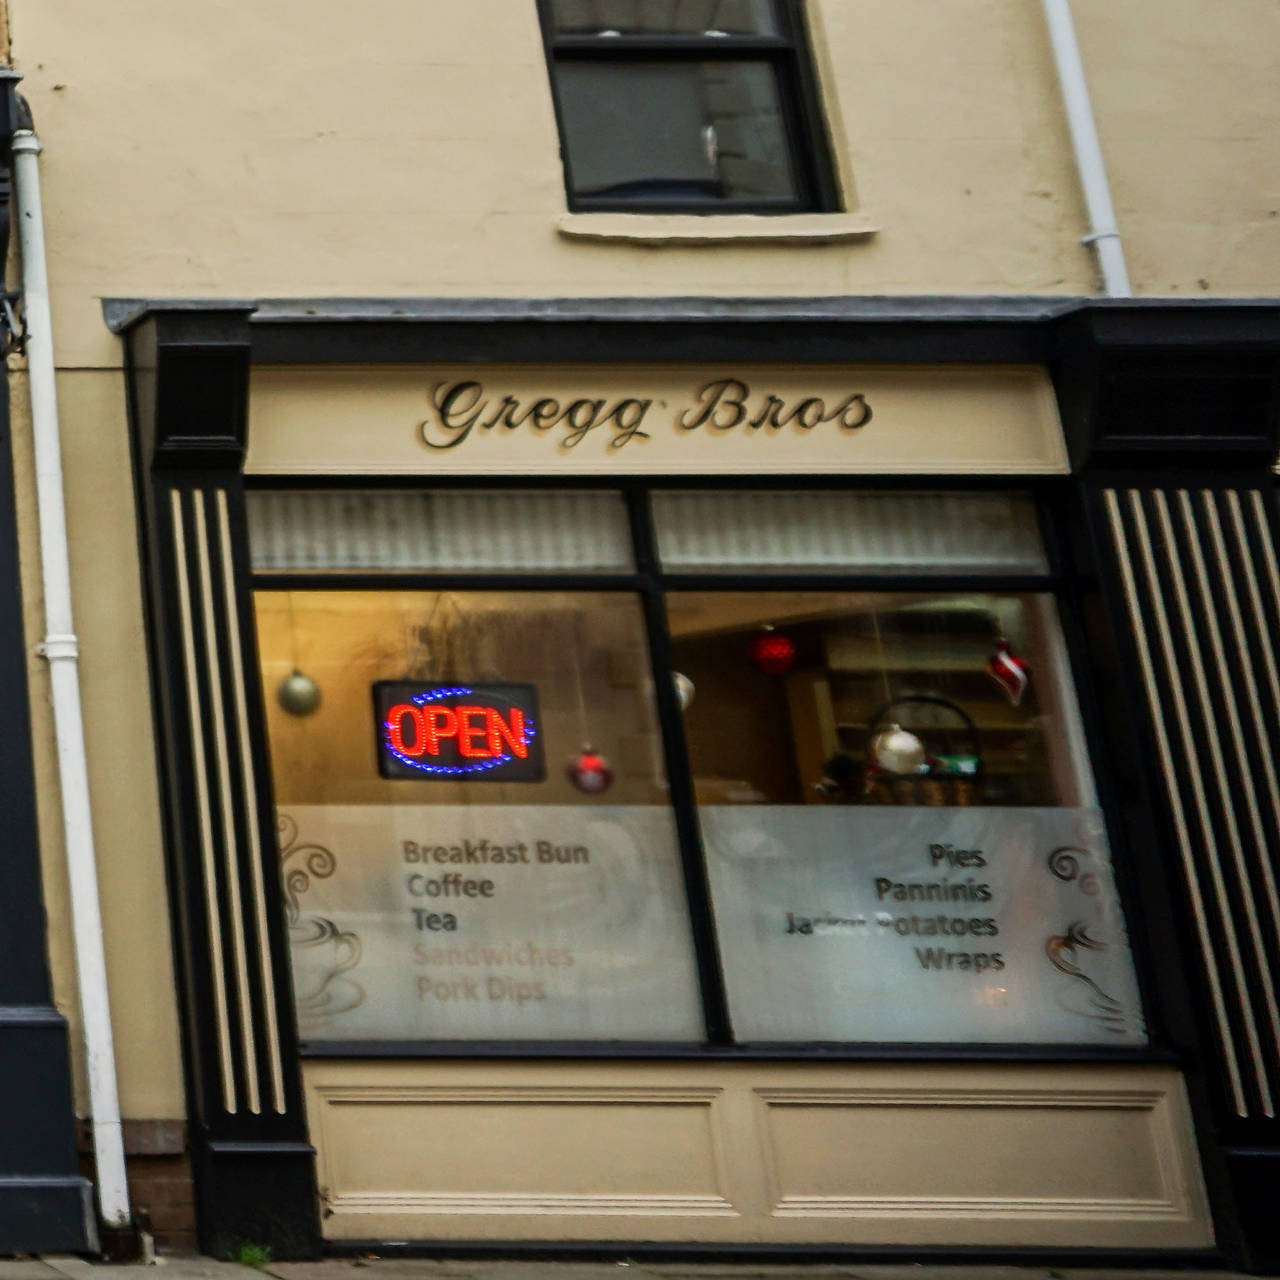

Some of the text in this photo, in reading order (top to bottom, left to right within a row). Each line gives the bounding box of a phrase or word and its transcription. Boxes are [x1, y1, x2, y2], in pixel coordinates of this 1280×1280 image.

[421, 378, 874, 449] Gregg Bros
[388, 704, 528, 759] OPEN
[403, 839, 589, 864] Breakfast Bun
[929, 843, 987, 868] Pies
[407, 873, 495, 898] Coffee
[875, 877, 993, 903] Panninis
[411, 907, 458, 931] Tea
[412, 942, 574, 967] Sandwiches
[914, 946, 1006, 973] Wraps
[416, 975, 547, 1006] Pork Dips
